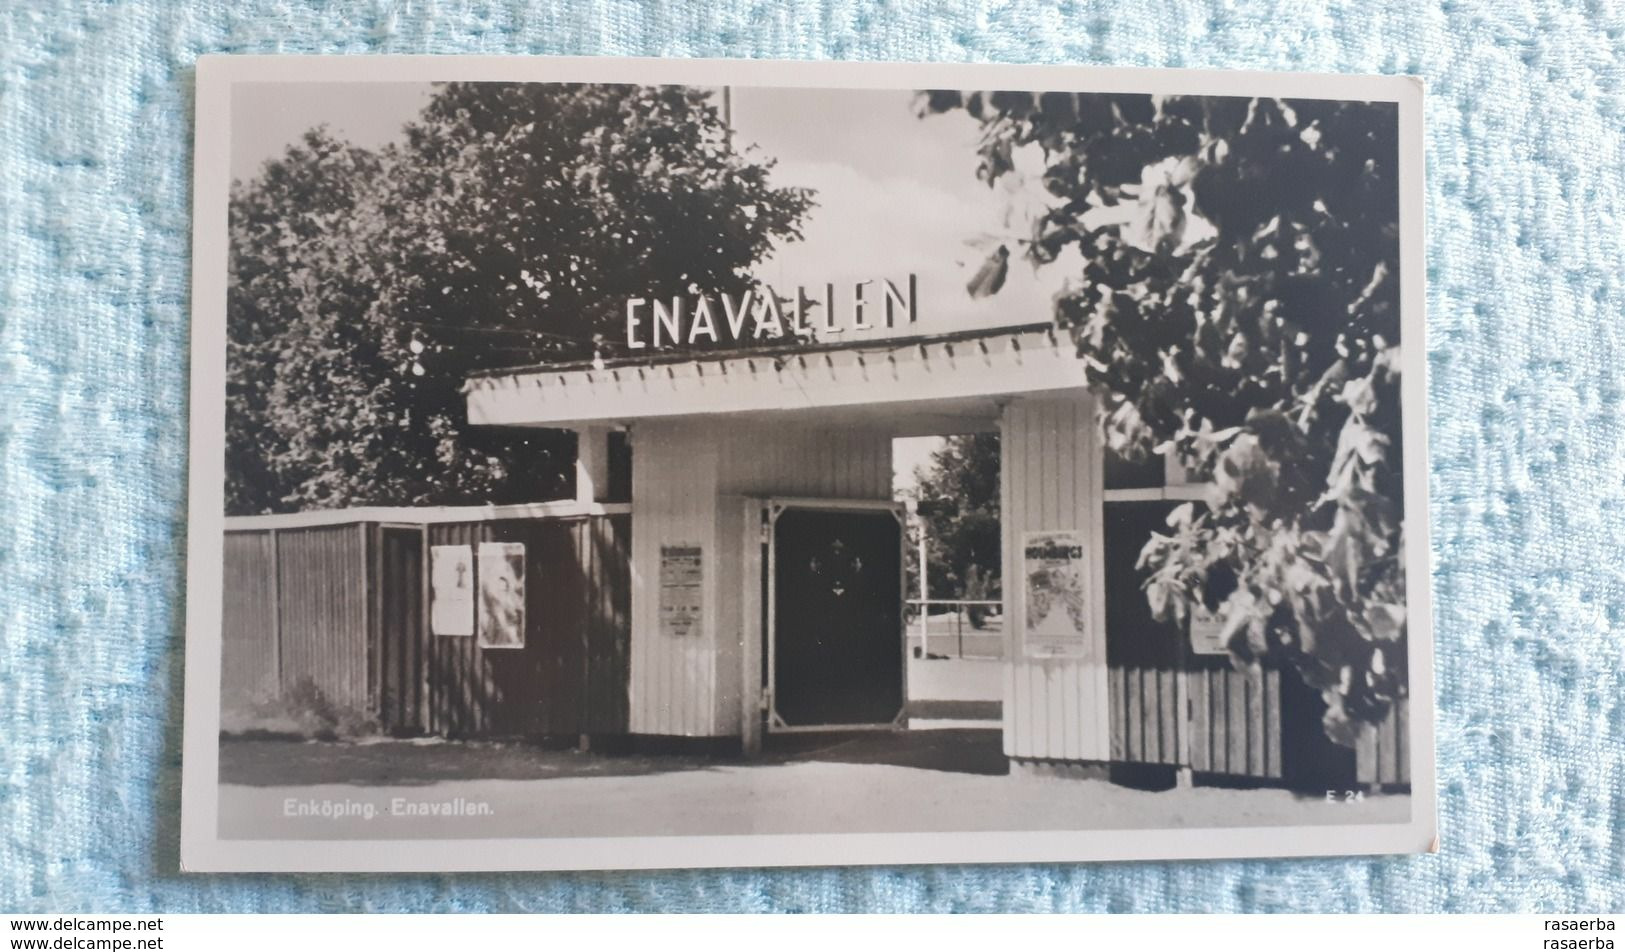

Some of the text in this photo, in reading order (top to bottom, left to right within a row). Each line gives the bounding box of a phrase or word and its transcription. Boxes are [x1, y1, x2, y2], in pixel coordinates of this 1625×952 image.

[626, 273, 917, 349] ENAVALLEN
[1326, 790, 1364, 804] E 24
[283, 798, 495, 820] Enköping. Enavallen.
